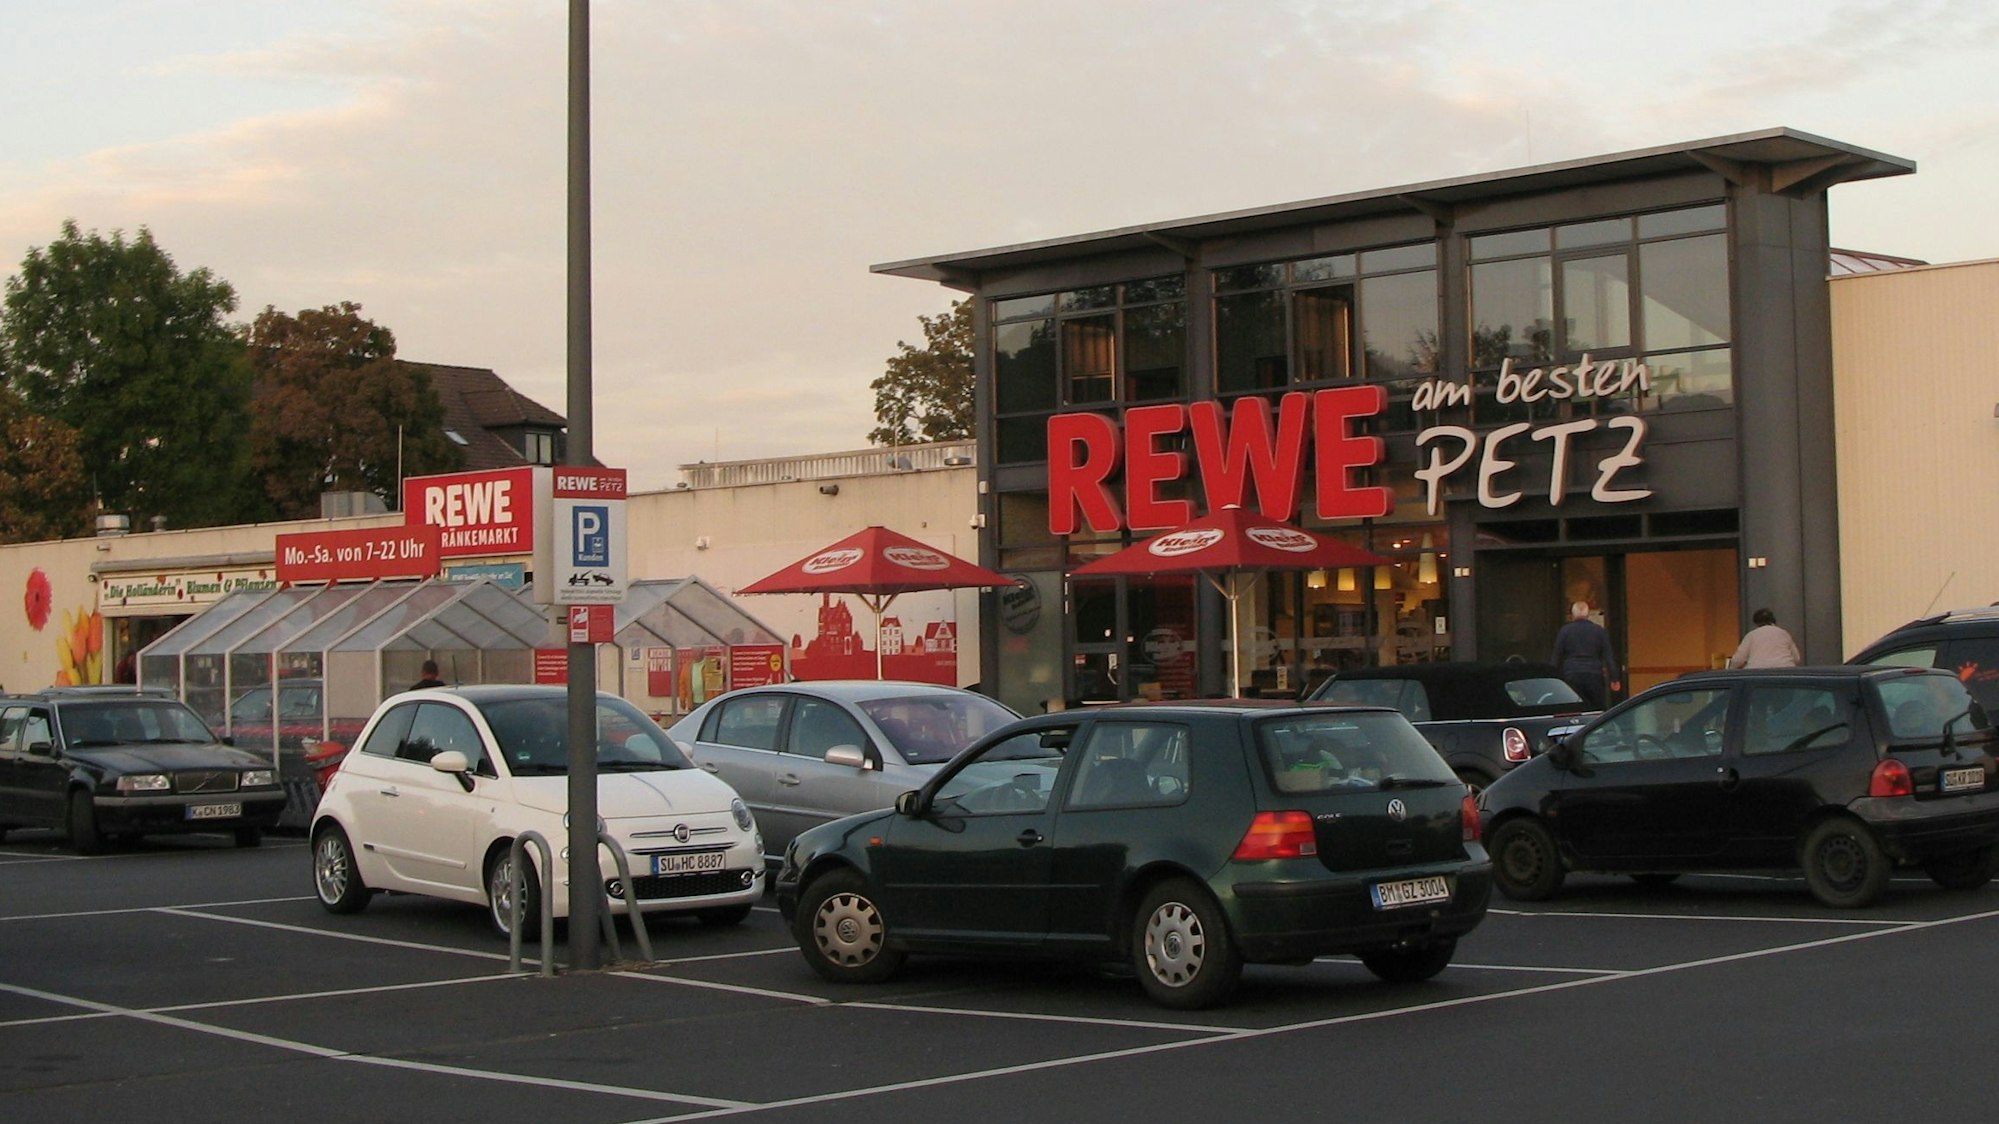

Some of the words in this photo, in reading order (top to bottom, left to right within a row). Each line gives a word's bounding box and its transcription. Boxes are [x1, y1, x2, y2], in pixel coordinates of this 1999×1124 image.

[1412, 380, 1472, 411] am
[1496, 352, 1652, 404] besten
[1047, 385, 1394, 535] REWE
[1414, 416, 1654, 516] PETZ
[557, 476, 597, 490] REWE
[426, 480, 512, 527] REWE
[442, 527, 518, 548] RÄNKEMARKT
[578, 512, 600, 552] P
[337, 547, 361, 562] von
[400, 538, 424, 558] Uhr
[187, 581, 220, 594] Blumen
[661, 857, 675, 871] SU
[682, 856, 695, 870] HC
[698, 854, 723, 869] 8887
[1379, 885, 1397, 902] BM
[1401, 882, 1418, 899] GZ
[1419, 880, 1446, 898] 3004
